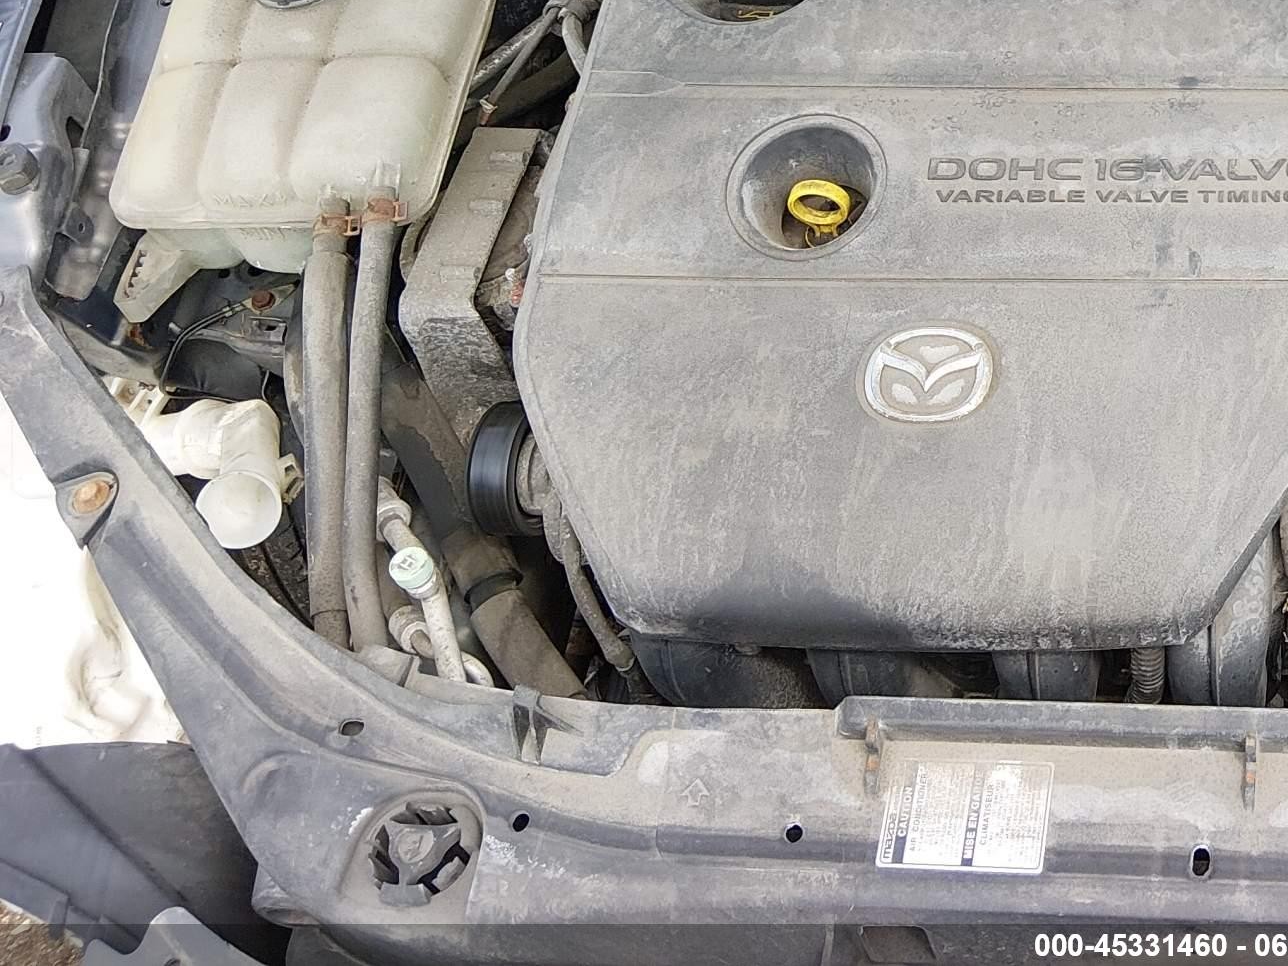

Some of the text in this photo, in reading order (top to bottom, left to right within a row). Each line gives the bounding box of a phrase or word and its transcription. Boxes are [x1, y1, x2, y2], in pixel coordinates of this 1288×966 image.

[926, 157, 1084, 182] DOHC
[936, 189, 1086, 204] VARIABLE
[1095, 189, 1189, 204] VALVE
[897, 786, 914, 838] CAUTION
[909, 773, 928, 852] AIR CONDITIONER
[968, 811, 980, 827] EN
[882, 810, 898, 859] mazda
